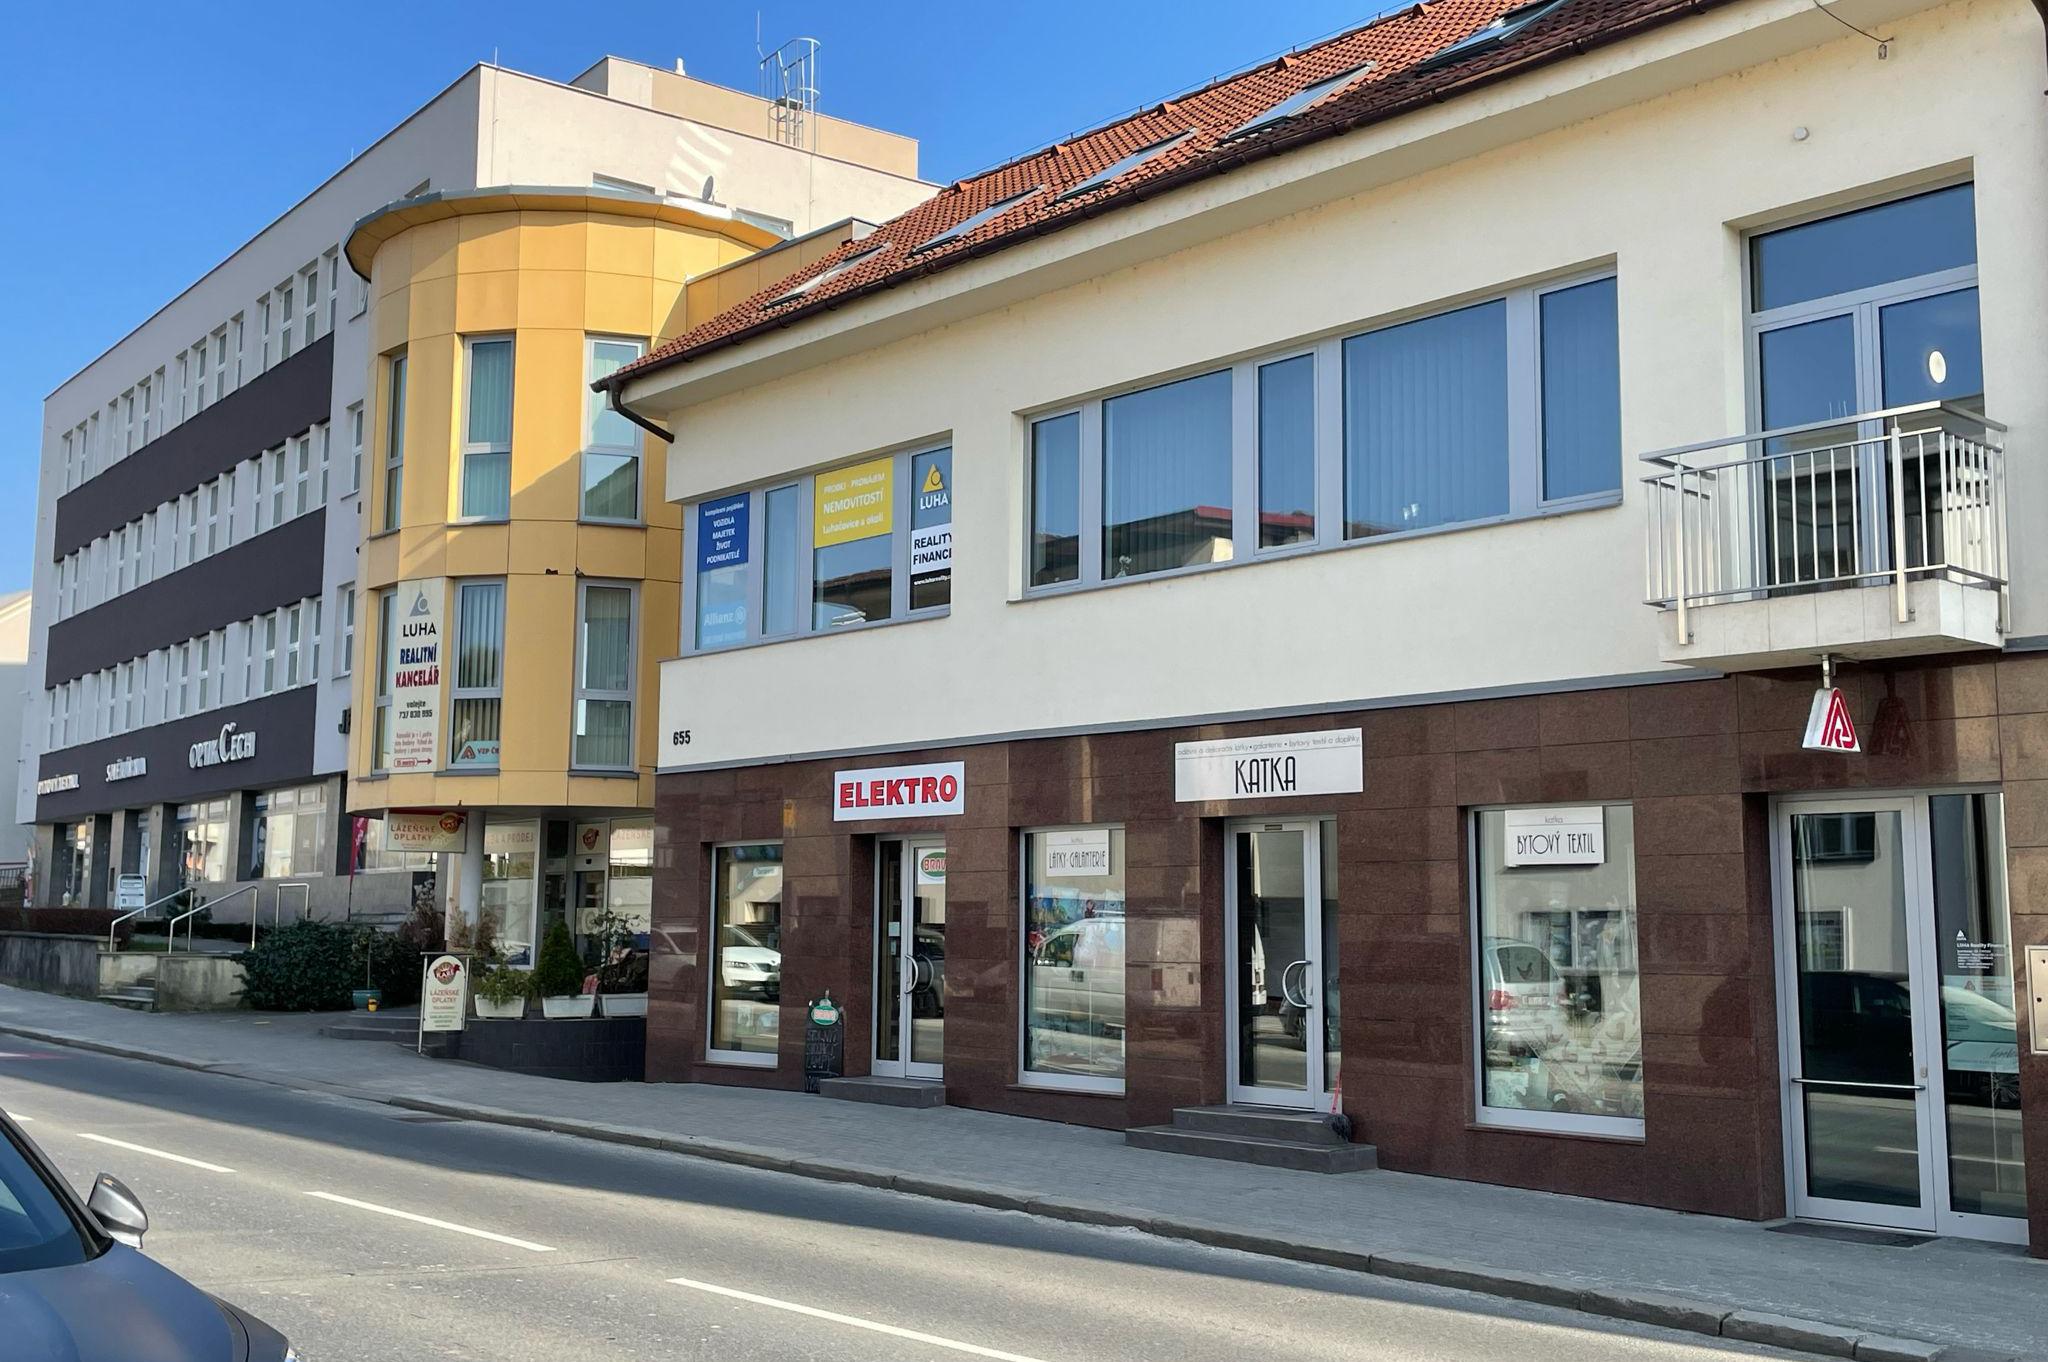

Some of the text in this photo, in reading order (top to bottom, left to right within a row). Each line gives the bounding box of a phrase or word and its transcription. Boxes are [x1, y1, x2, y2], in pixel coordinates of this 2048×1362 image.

[823, 487, 884, 514] NEMOVITOSTÍ
[919, 493, 949, 510] LUHA
[713, 516, 735, 528] VOZIDLA
[712, 528, 735, 540] MAJETEK
[716, 540, 731, 551] ŽIVOT
[706, 549, 740, 564] PODNIKATELÉ
[704, 612, 734, 626] Allianz
[402, 622, 437, 637] LUHA
[400, 643, 437, 665] REALITNÍ
[396, 665, 439, 688] KANCELÁŘ
[673, 730, 690, 745] 655
[189, 739, 221, 769] OPTIK
[1235, 756, 1296, 794] KATKA
[839, 775, 958, 809] ELEKTRO
[394, 833, 432, 841] OPLATKY
[1517, 830, 1596, 855] BYTOVÝ TEXTIL
